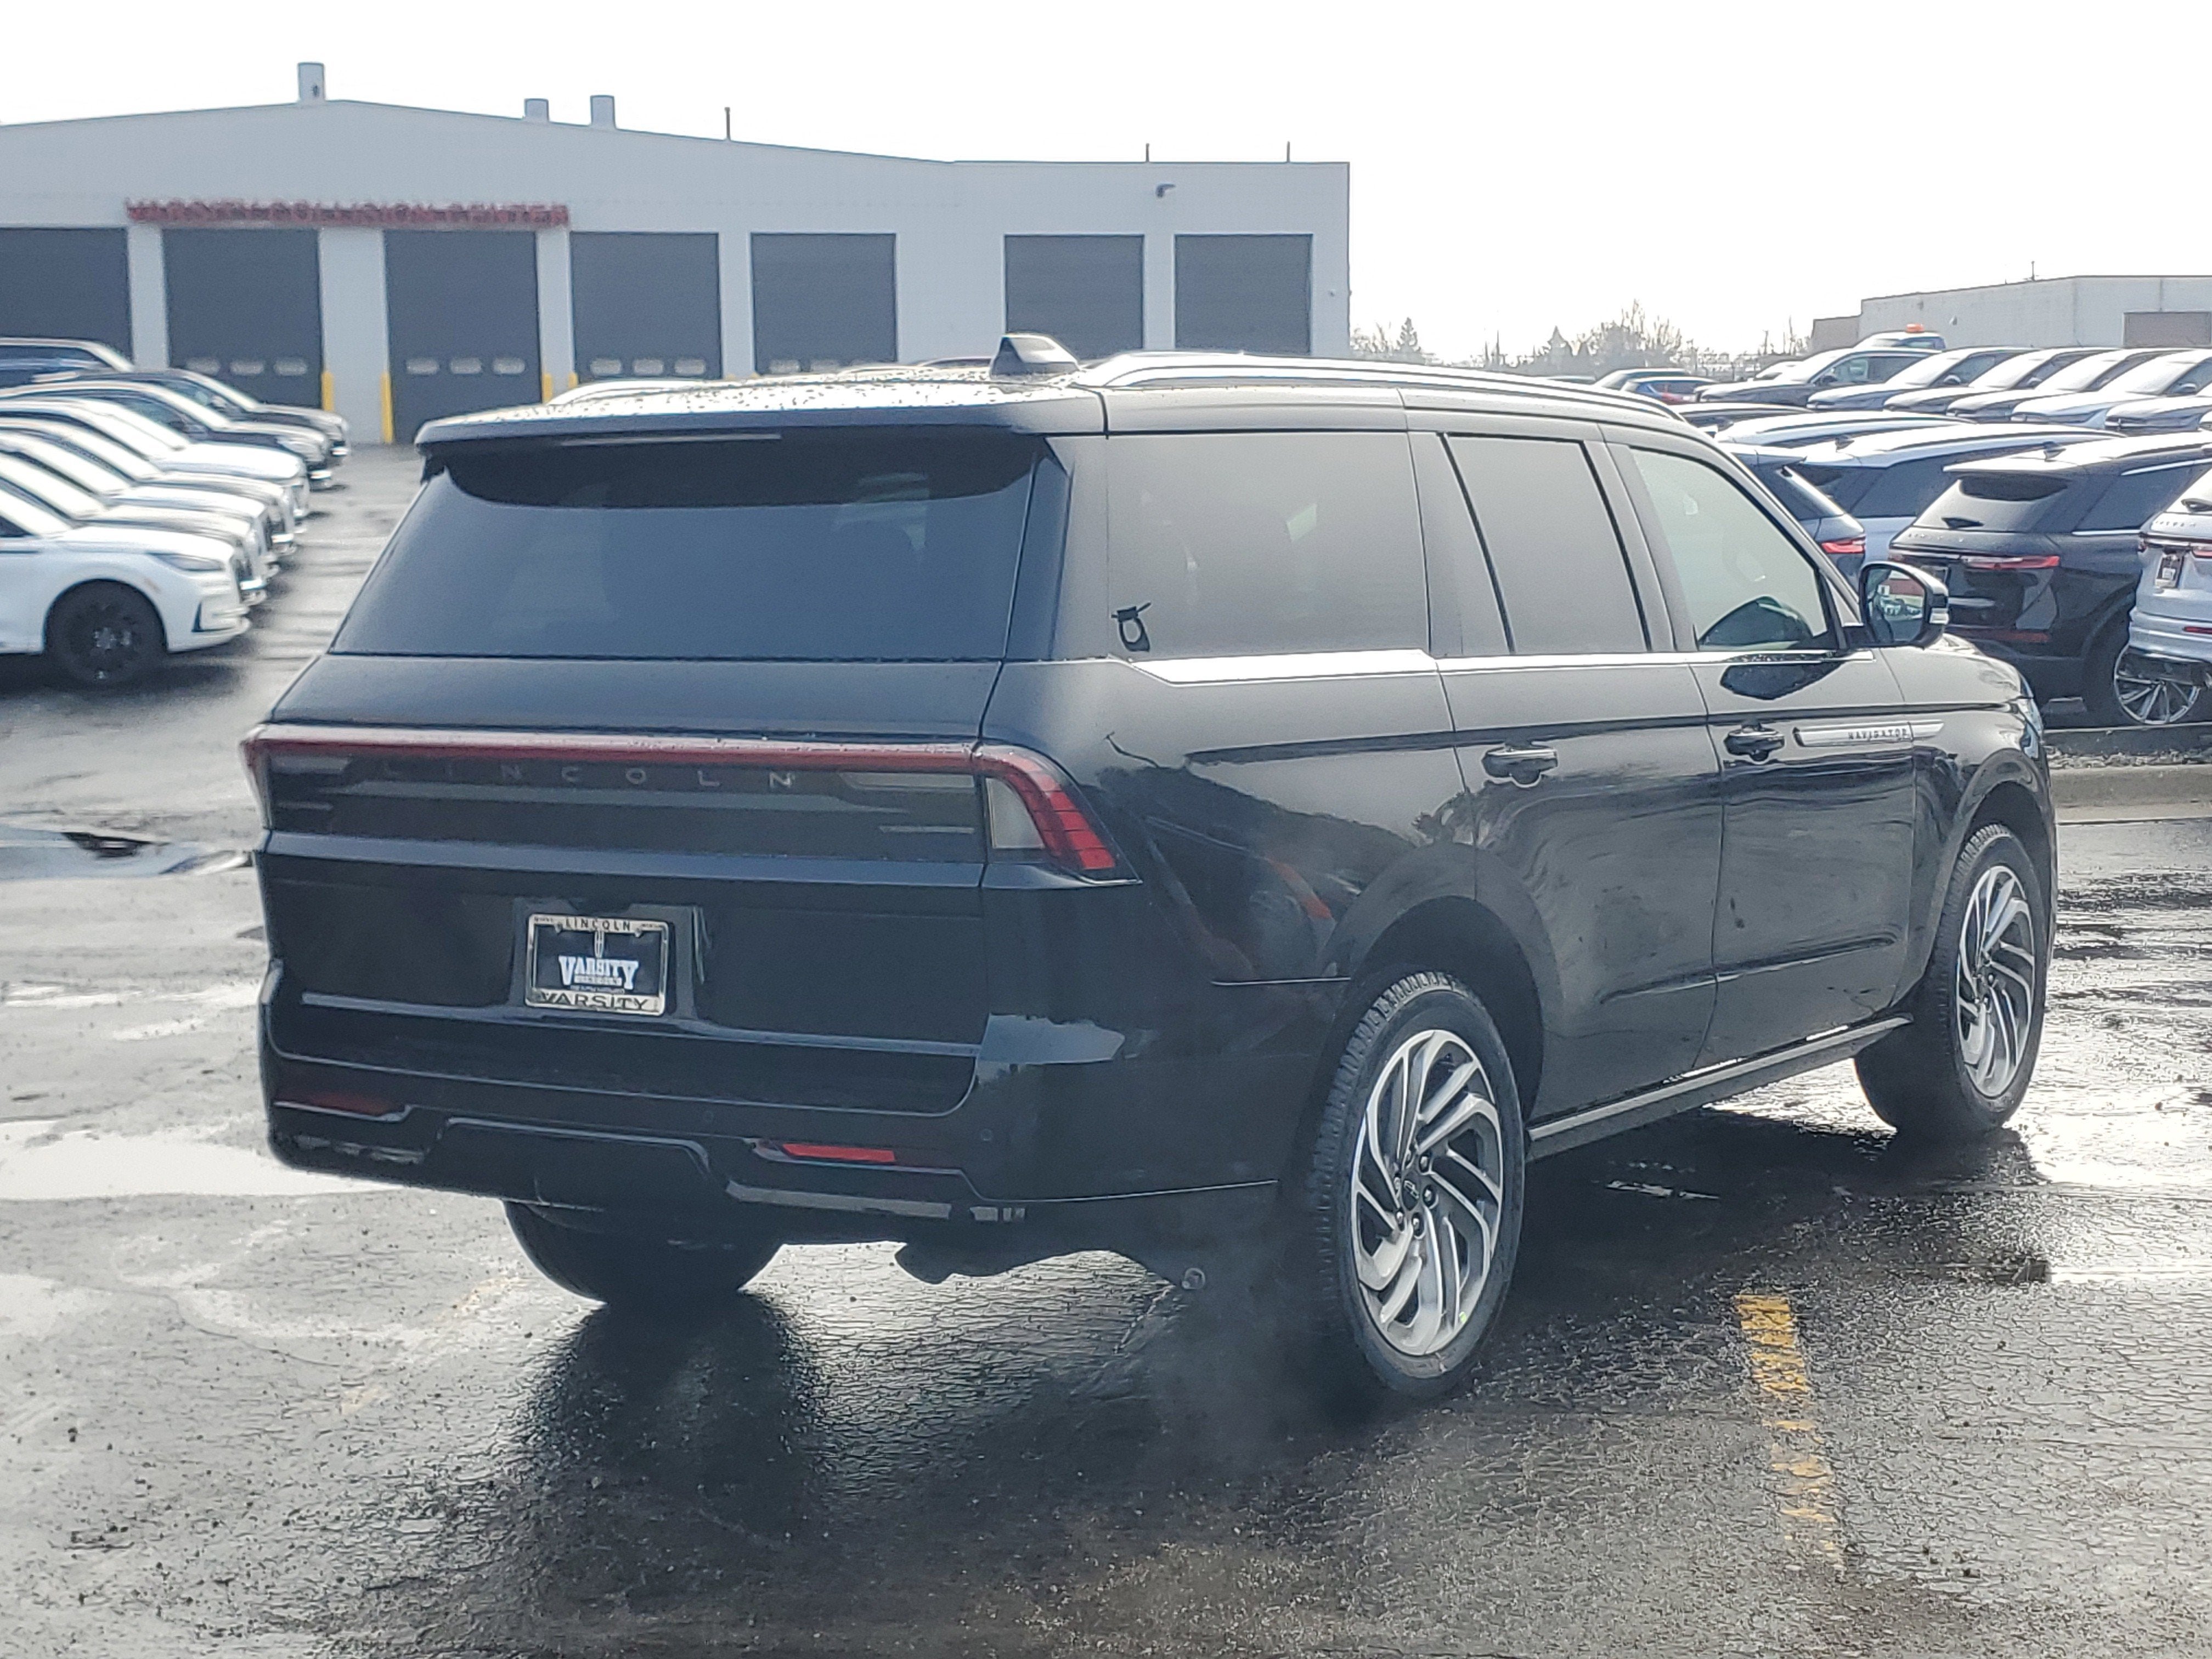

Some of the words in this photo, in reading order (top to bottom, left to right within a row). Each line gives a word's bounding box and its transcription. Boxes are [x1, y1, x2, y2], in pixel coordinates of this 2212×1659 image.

[1847, 727, 1909, 740] NAVIGATOR
[381, 762, 795, 788] LINCOLN
[565, 916, 631, 932] LINCOLN
[558, 955, 639, 990] VARSITY
[540, 991, 648, 1011] VARSITY
